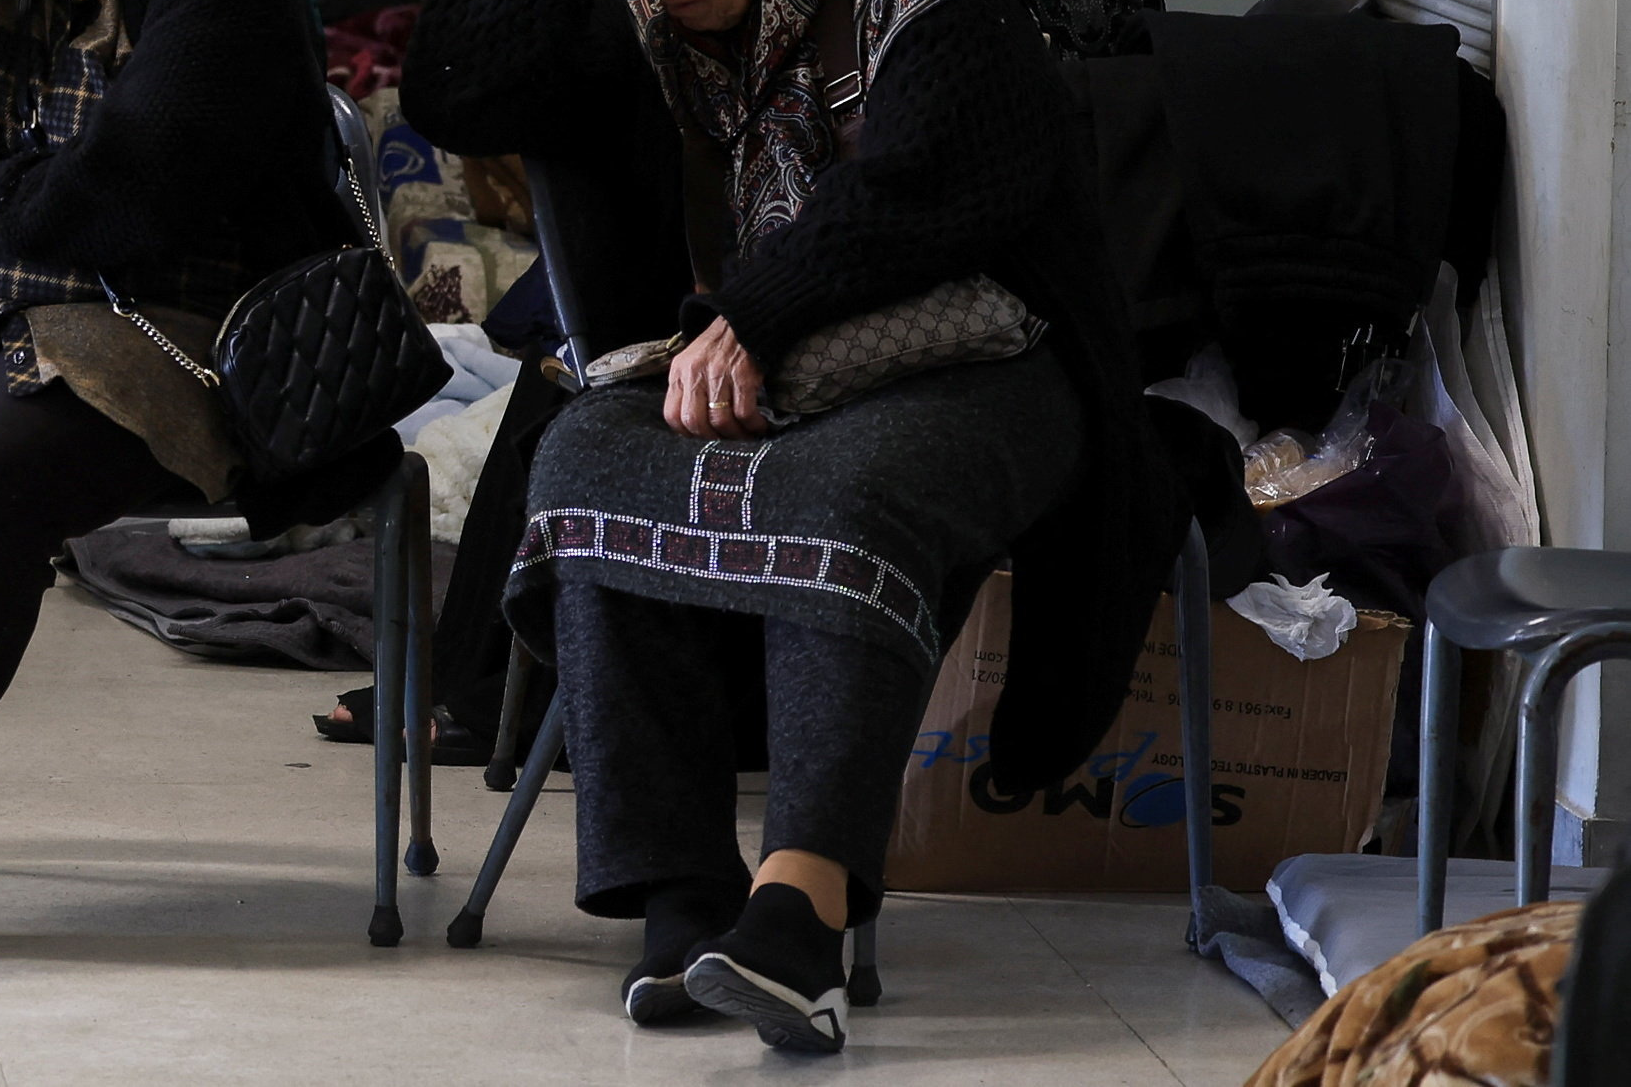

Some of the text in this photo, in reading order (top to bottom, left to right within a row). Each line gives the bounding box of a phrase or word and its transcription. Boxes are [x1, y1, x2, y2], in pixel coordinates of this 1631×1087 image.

[1225, 700, 1234, 711] 8
[1239, 701, 1261, 715] 961
[1265, 703, 1291, 719] Fax:
[1236, 761, 1284, 778] PLASTIC
[1287, 767, 1298, 779] IN
[1301, 766, 1347, 783] LEADER
